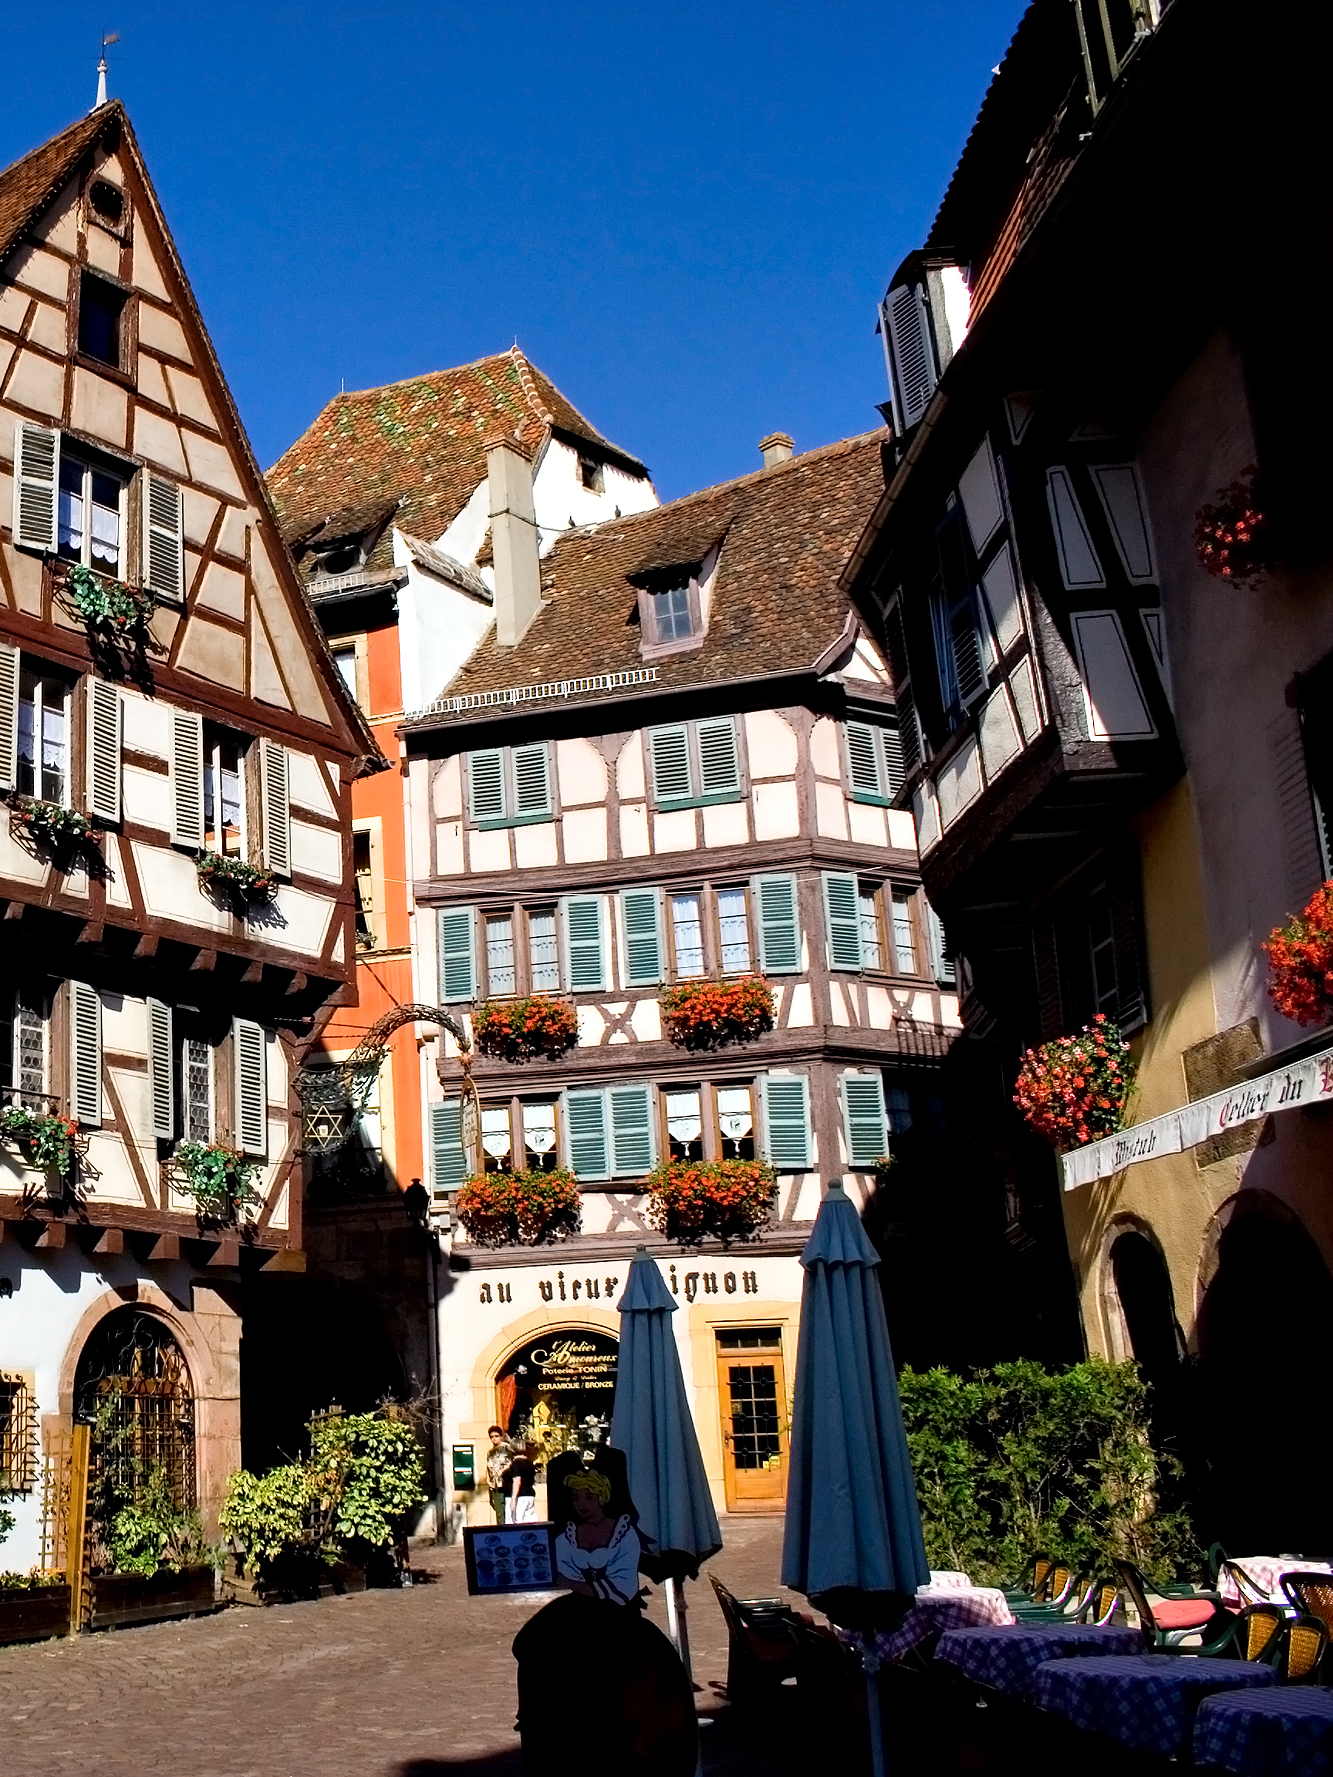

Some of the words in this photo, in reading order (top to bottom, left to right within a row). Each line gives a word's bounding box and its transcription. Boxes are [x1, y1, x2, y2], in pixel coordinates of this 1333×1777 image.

[1219, 1089, 1269, 1127] Cellier
[1278, 1072, 1304, 1104] du
[479, 1282, 513, 1304] au
[538, 1270, 619, 1303] vieux
[668, 1263, 759, 1304] ignon
[577, 1365, 608, 1374] TONIN
[585, 1380, 614, 1389] BRONZE
